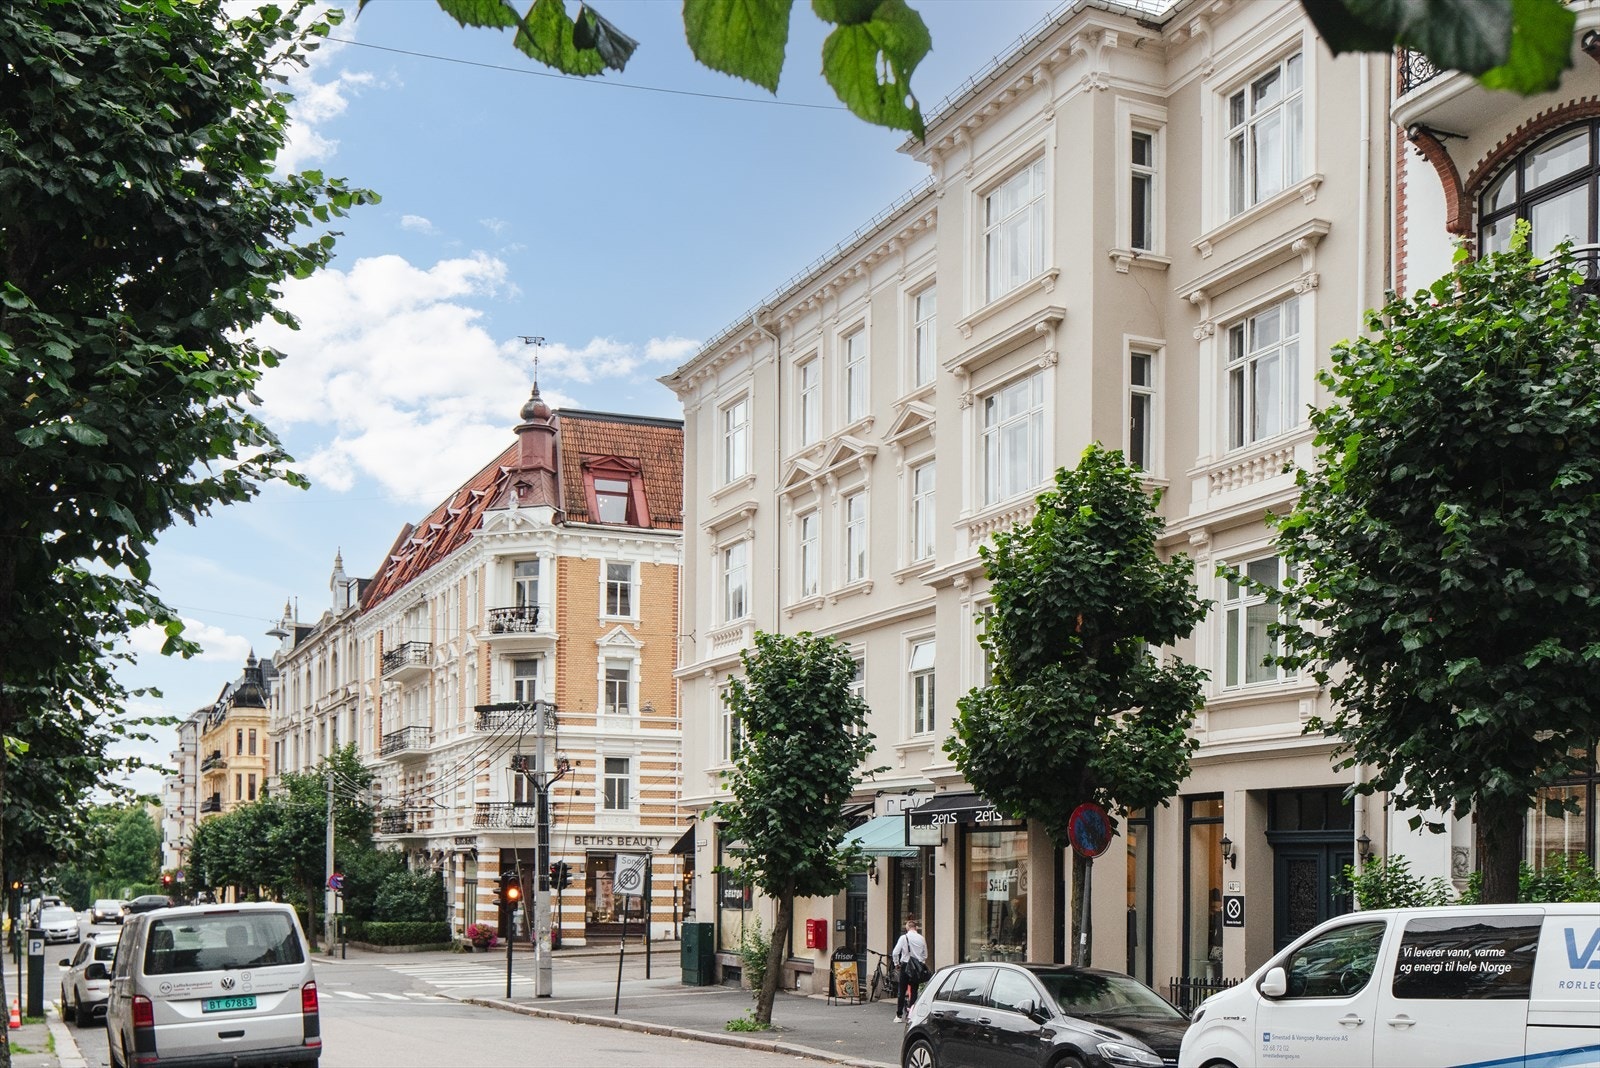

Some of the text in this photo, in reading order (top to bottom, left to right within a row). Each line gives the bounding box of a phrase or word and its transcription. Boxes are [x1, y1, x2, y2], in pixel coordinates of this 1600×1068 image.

[931, 812, 958, 825] zens
[974, 810, 1003, 823] zens
[574, 835, 663, 847] BETH'S BEAUTY
[989, 878, 1008, 892] SALG
[32, 941, 42, 953] P
[1403, 947, 1506, 958] Vi leverer vann, varme
[835, 952, 854, 961] frisør
[1400, 961, 1512, 975] og energi til hele Norge
[209, 998, 254, 1009] BT 67883
